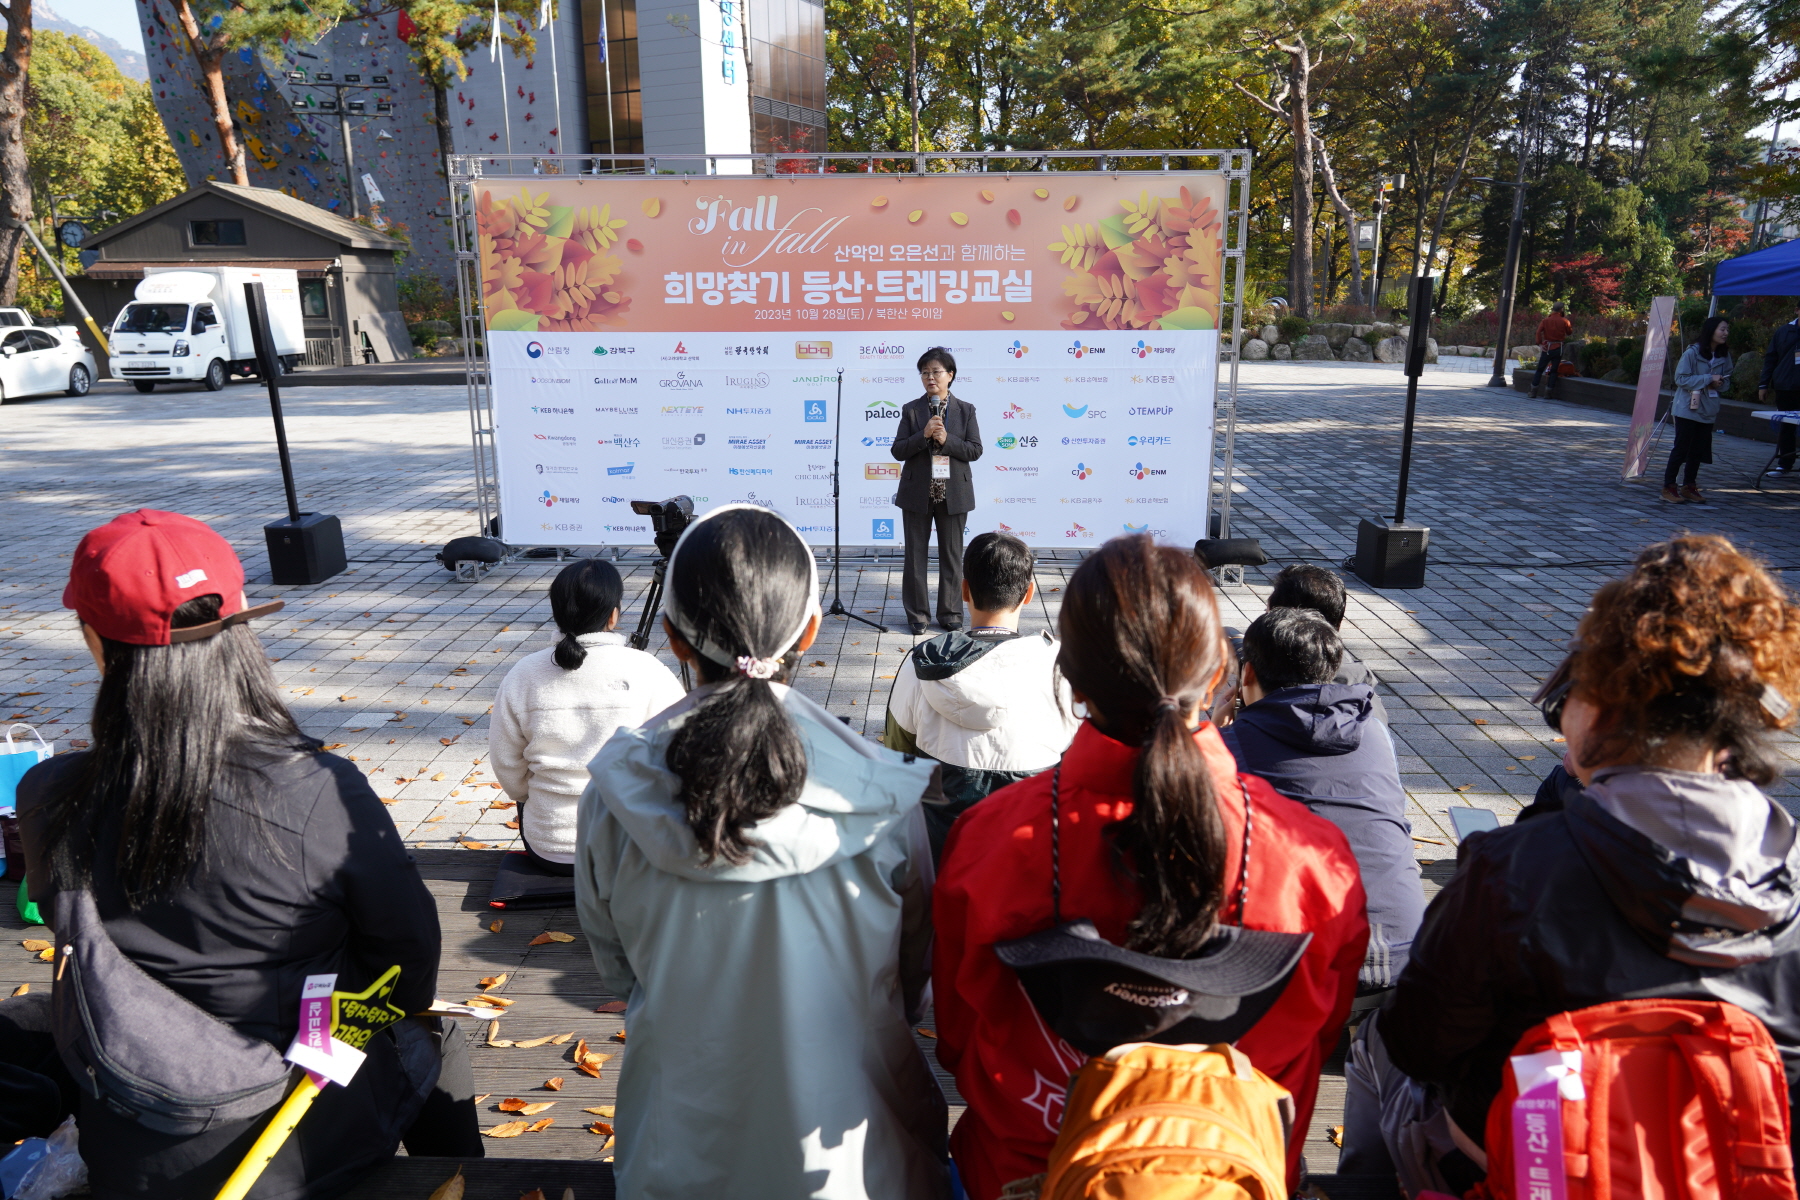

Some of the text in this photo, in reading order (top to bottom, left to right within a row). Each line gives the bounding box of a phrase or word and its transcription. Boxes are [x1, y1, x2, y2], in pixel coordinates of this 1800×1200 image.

[688, 194, 778, 235] Fall
[722, 208, 851, 268] in fall
[834, 244, 1026, 262] 산악인 오은선과 함께하는
[664, 270, 1032, 306] 희망찾기 등산·트레킹교실
[754, 308, 792, 320] 2023년
[796, 308, 819, 320] 10월
[822, 308, 865, 321] 28일(토)
[876, 308, 908, 320] 북한산
[912, 308, 944, 320] 우이암
[547, 346, 570, 355] 산림청
[609, 346, 636, 354] 강북구
[865, 407, 901, 421] paleo
[1088, 411, 1107, 419] SPC
[614, 438, 641, 448] 백산수
[662, 437, 692, 446] 대신증권
[1019, 436, 1039, 448] 신송
[1139, 436, 1171, 445] 우리카드
[860, 497, 890, 505] 대신증권
[345, 1001, 390, 1024] 탱자탱자
